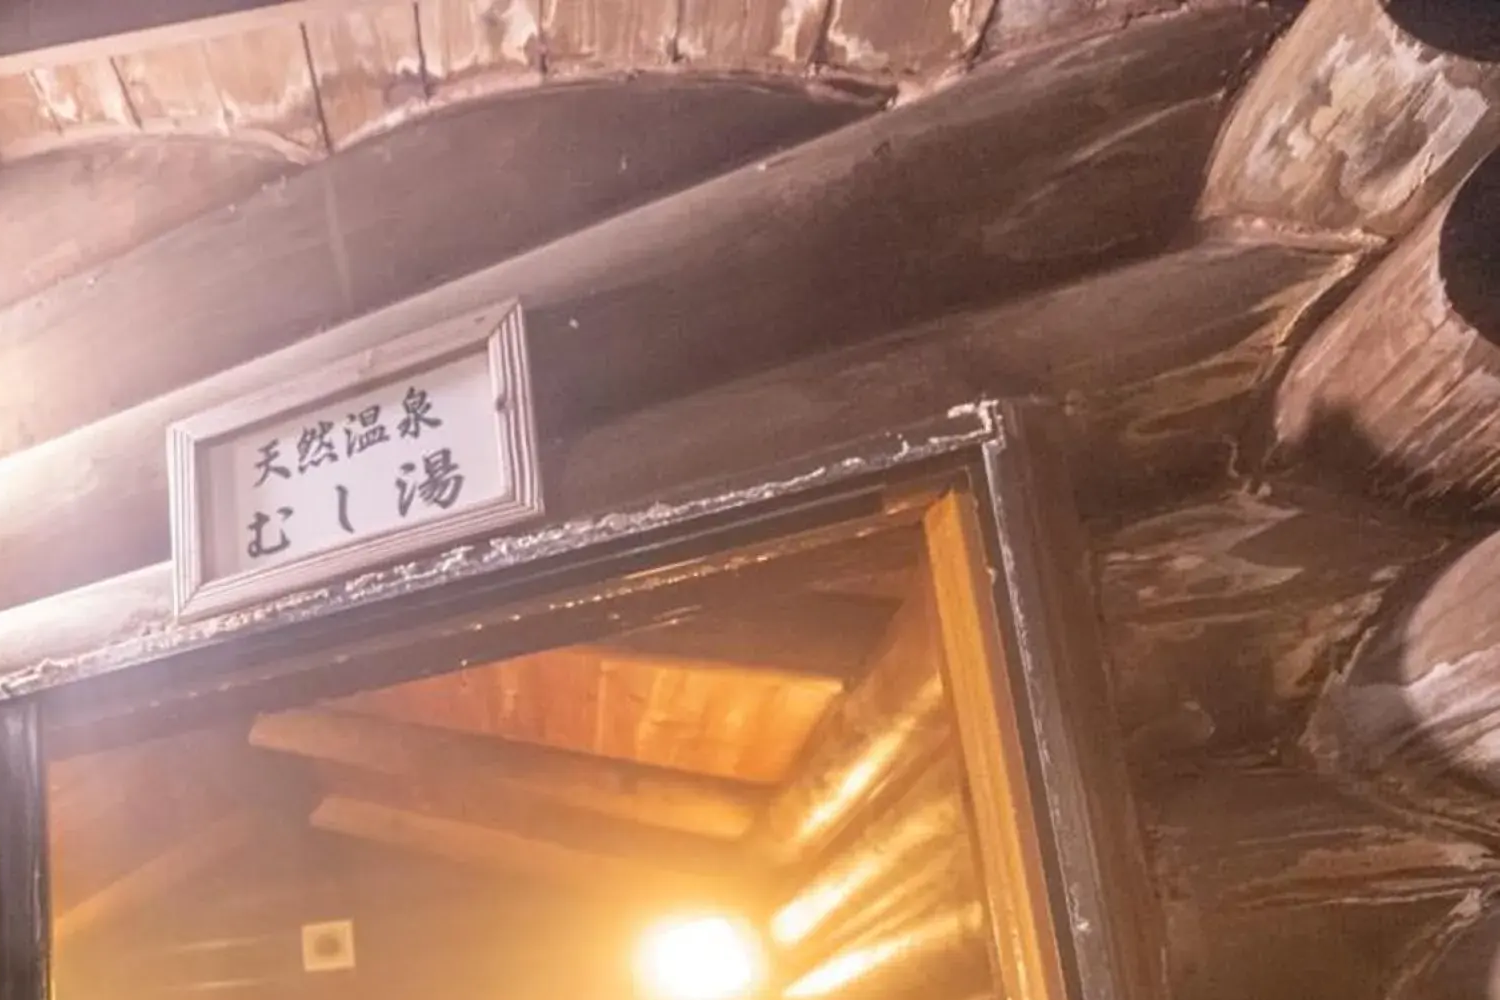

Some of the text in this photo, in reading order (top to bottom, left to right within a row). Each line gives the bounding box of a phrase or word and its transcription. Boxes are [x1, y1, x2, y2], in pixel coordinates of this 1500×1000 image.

[252, 385, 444, 488] 天然温泉
[245, 446, 467, 559] むし湯
